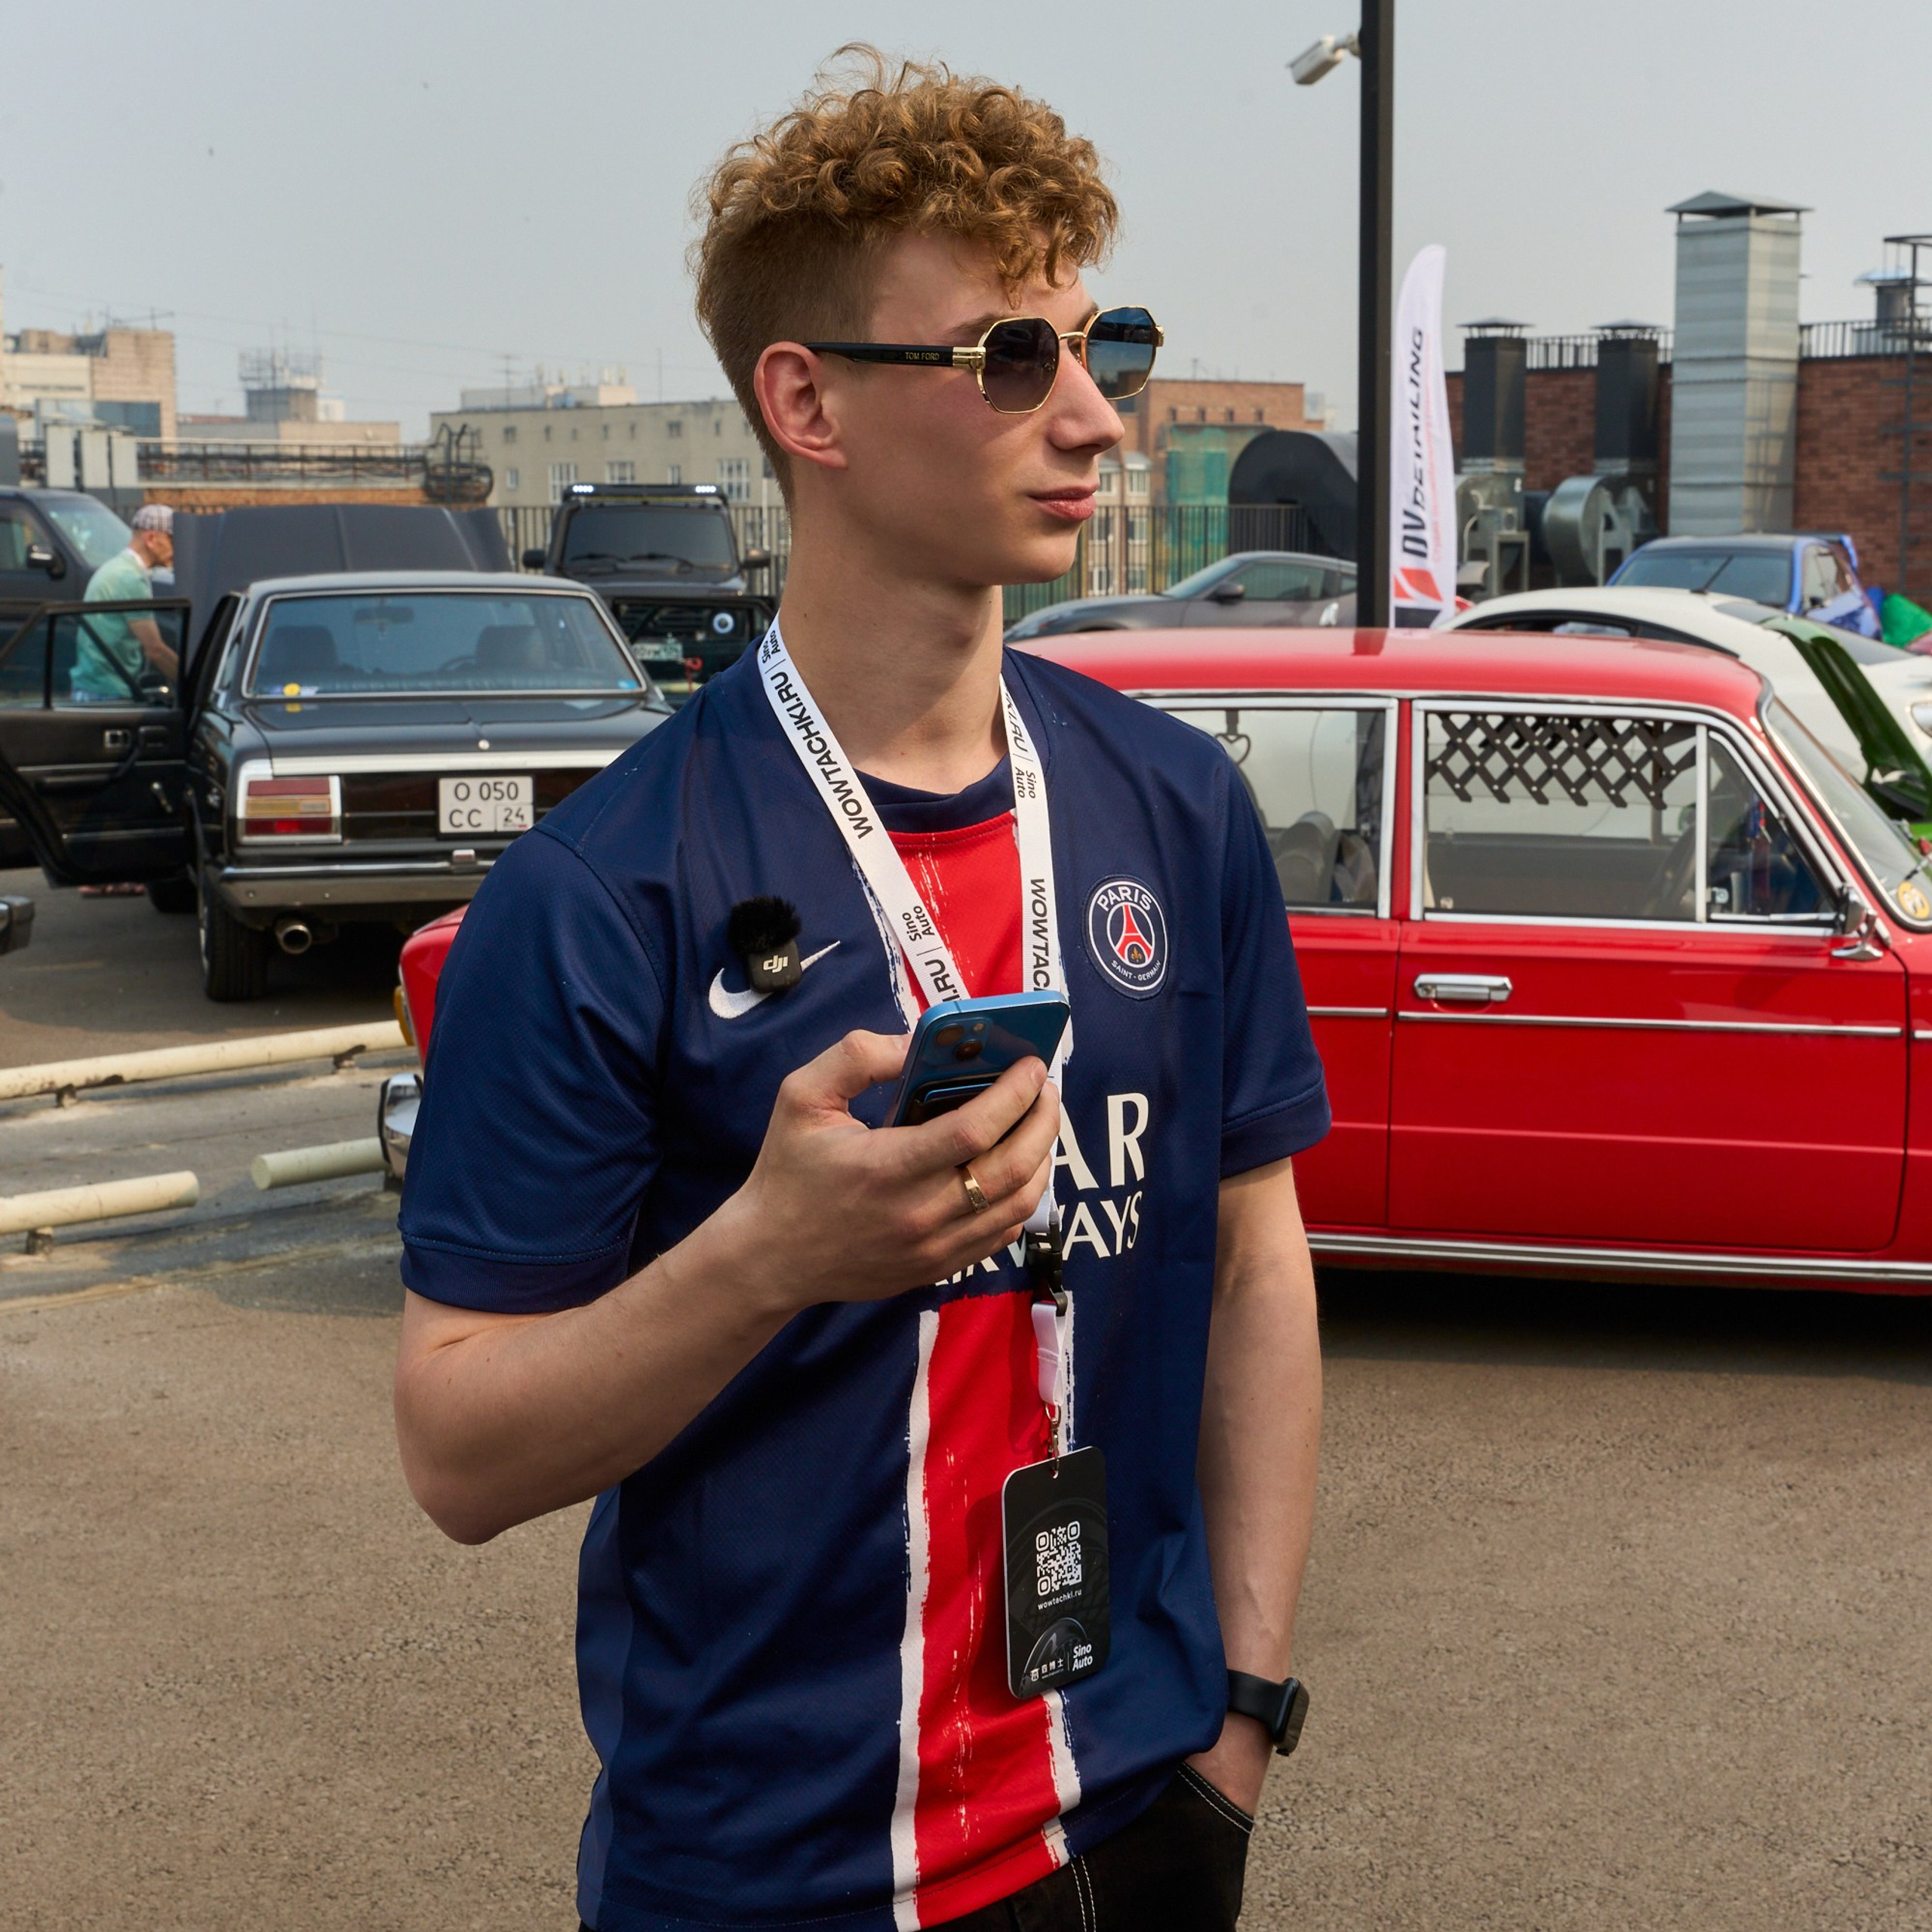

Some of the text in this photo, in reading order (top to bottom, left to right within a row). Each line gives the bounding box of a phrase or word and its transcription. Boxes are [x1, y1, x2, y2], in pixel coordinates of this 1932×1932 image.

[905, 351, 940, 361] TOM FORD
[761, 640, 772, 664] Sino
[770, 629, 781, 654] Auto
[770, 671, 873, 840] WOWTACHKI.RU
[479, 781, 518, 801] 050
[1014, 766, 1026, 798] Auto
[1026, 770, 1036, 799] Sino
[503, 807, 525, 823] 24
[1097, 886, 1152, 912] PARIS
[902, 912, 922, 942] Sino
[913, 905, 935, 936] Auto
[1030, 878, 1051, 992] WOWTAC
[1037, 1589, 1082, 1611] wowtachki.ru
[1072, 1644, 1093, 1659] Sino
[1072, 1655, 1094, 1672] Auto
